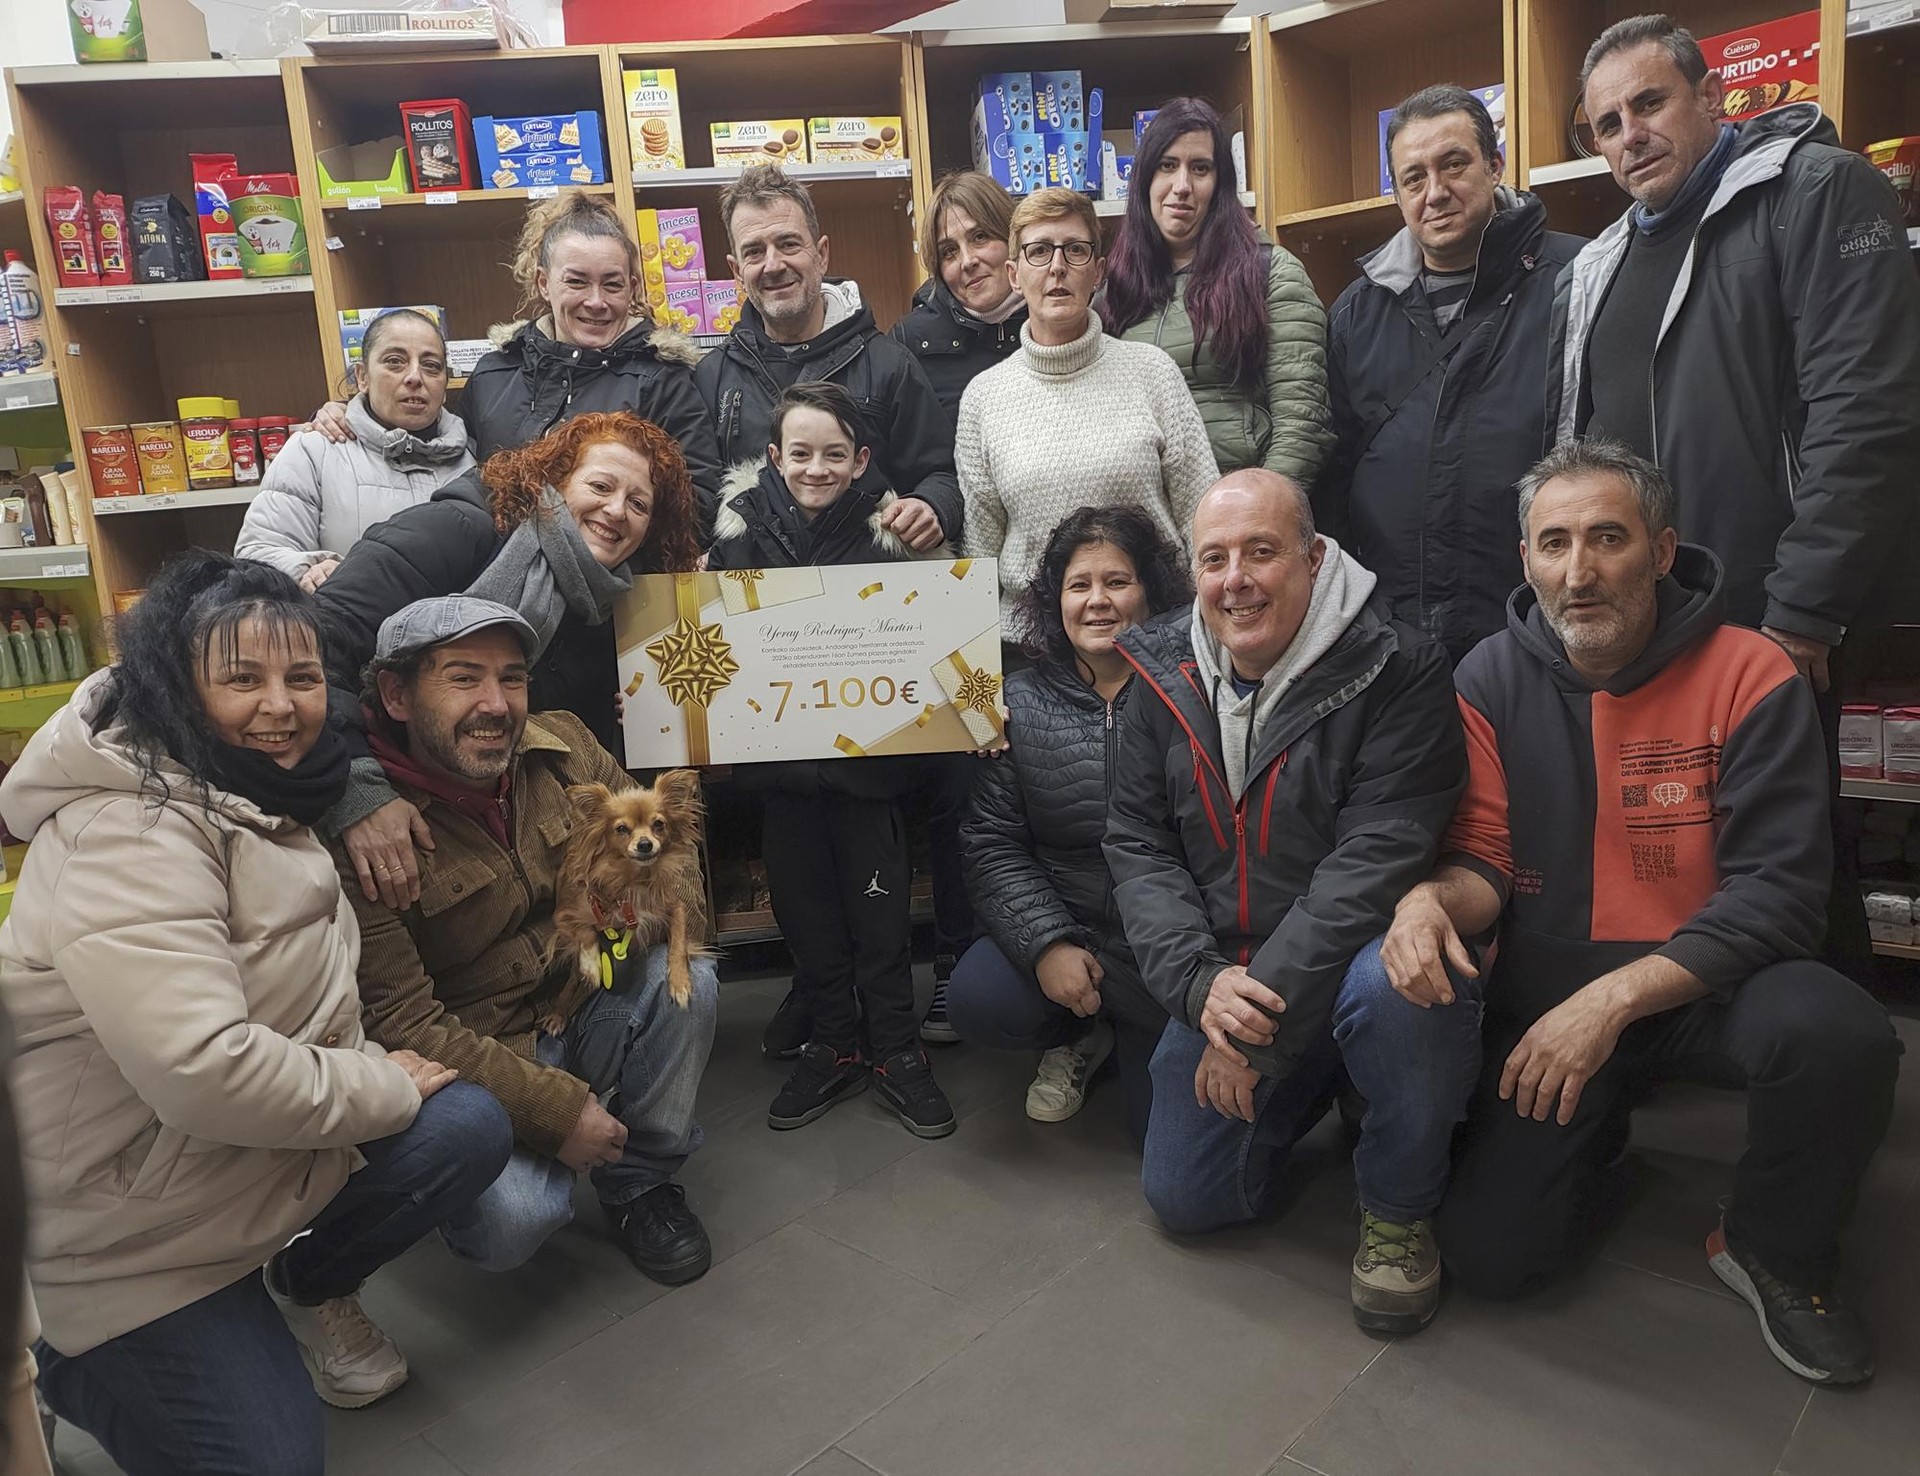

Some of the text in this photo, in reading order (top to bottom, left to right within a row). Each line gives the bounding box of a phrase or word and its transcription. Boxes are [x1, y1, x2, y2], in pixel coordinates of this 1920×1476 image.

[411, 18, 475, 31] ROLLITOS
[1724, 42, 1758, 56] Cuétara
[1716, 53, 1779, 80] URTIDO
[634, 90, 668, 102] zero
[1047, 84, 1061, 128] OREO
[410, 119, 454, 133] ROLLITOS
[525, 122, 550, 130] ARTIACH
[736, 125, 767, 136] zero
[836, 121, 866, 132] zero
[528, 157, 554, 165] ARTIACH
[1058, 145, 1073, 189] OREO
[1008, 148, 1024, 193] OREO
[1881, 162, 1911, 178] cilla
[245, 180, 272, 194] Melitta
[327, 184, 352, 196] gullón
[243, 204, 284, 214] ORIGINAL
[657, 213, 697, 231] rincesa
[139, 233, 167, 244] AITONA
[187, 428, 220, 438] LEROUX
[91, 445, 126, 455] MARCILLA
[139, 442, 174, 452] MARCILLA
[759, 623, 800, 643] Yeray
[769, 675, 919, 723] 7.100€
[1621, 762, 1637, 770] THIS
[1638, 758, 1672, 768] GARMENT
[1673, 756, 1689, 766] WAS
[1621, 767, 1664, 777] DEVELOPED
